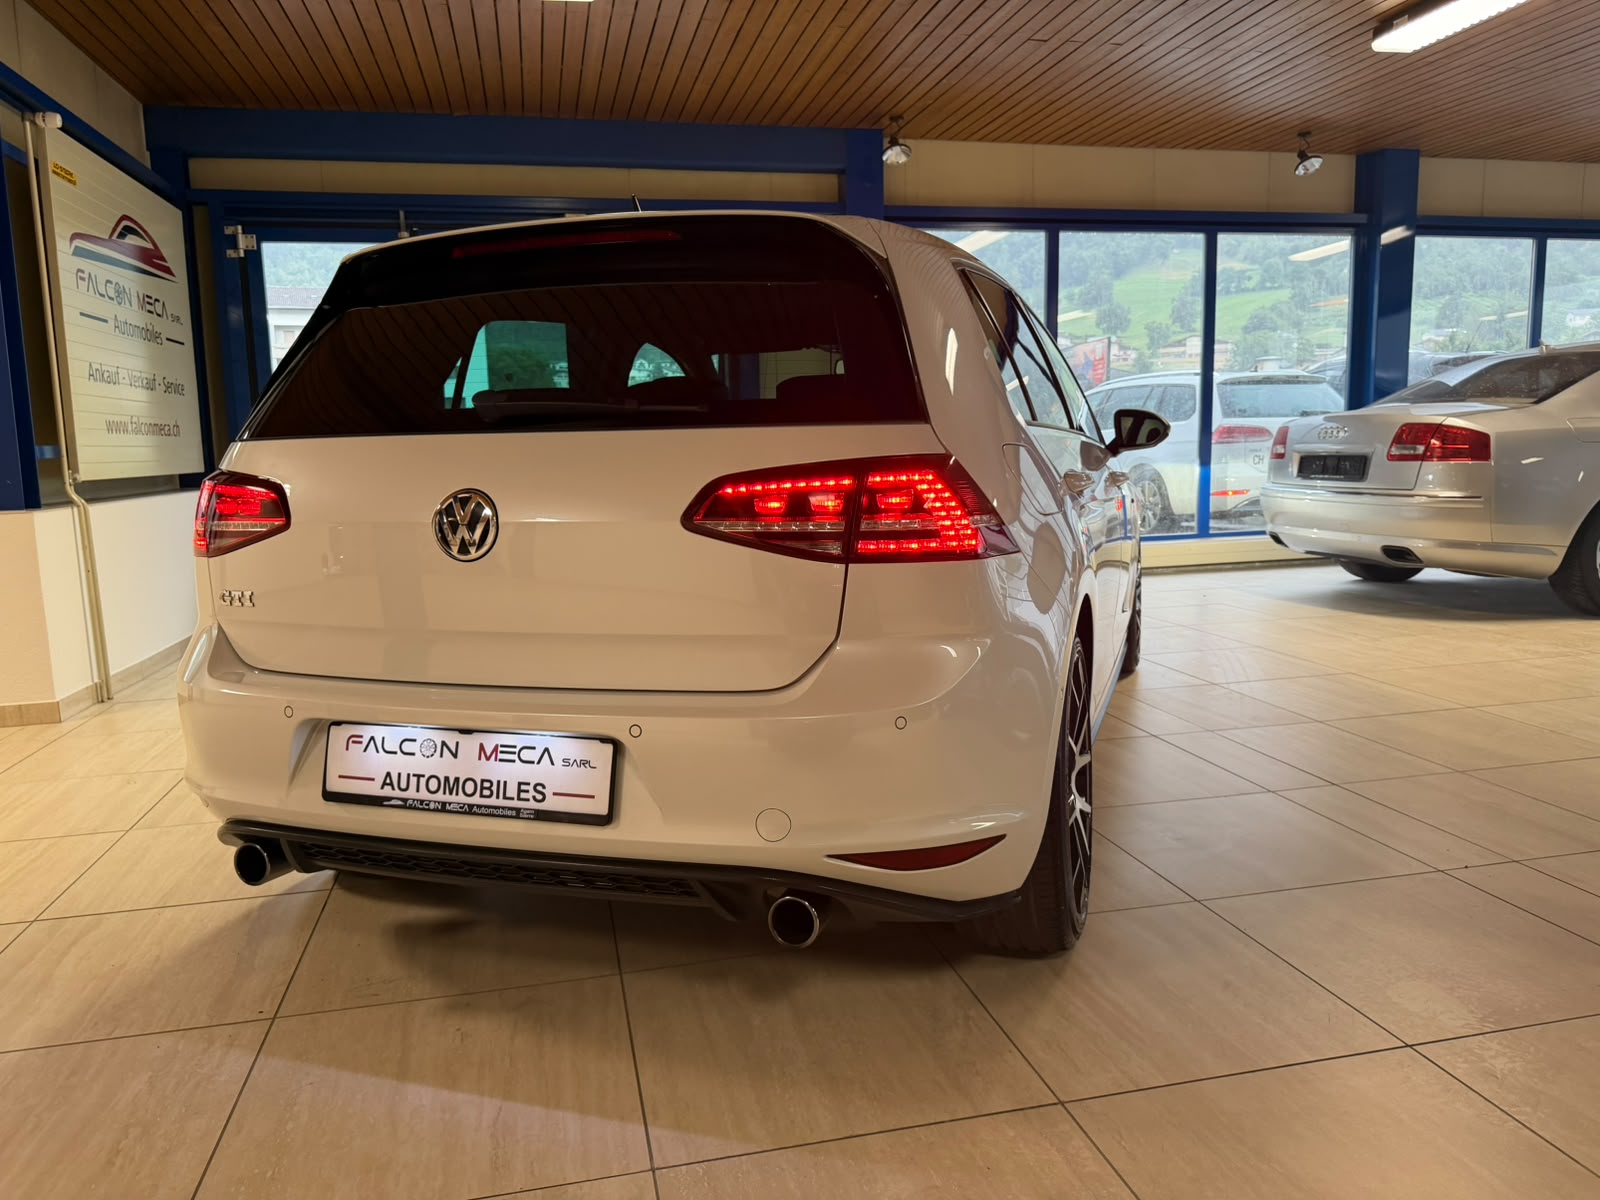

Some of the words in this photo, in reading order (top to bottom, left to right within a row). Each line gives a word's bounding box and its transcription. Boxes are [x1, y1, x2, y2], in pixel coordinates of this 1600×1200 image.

[75, 268, 132, 307] FALCON
[136, 290, 169, 320] MECA
[114, 314, 163, 345] Automobiles
[88, 362, 120, 386] Ankauf
[127, 369, 157, 391] Verkauf
[162, 376, 185, 396] Service
[105, 415, 180, 437] www.falconmeca.ch
[1253, 454, 1264, 466] CH
[219, 589, 255, 607] GTI
[345, 734, 459, 759] FALCON
[478, 742, 555, 766] MECA
[562, 758, 597, 769] SARL
[380, 771, 547, 803] AUTOMOBILES
[406, 799, 442, 810] FALCON
[446, 803, 469, 812] MECA
[472, 805, 516, 816] Automobiles
